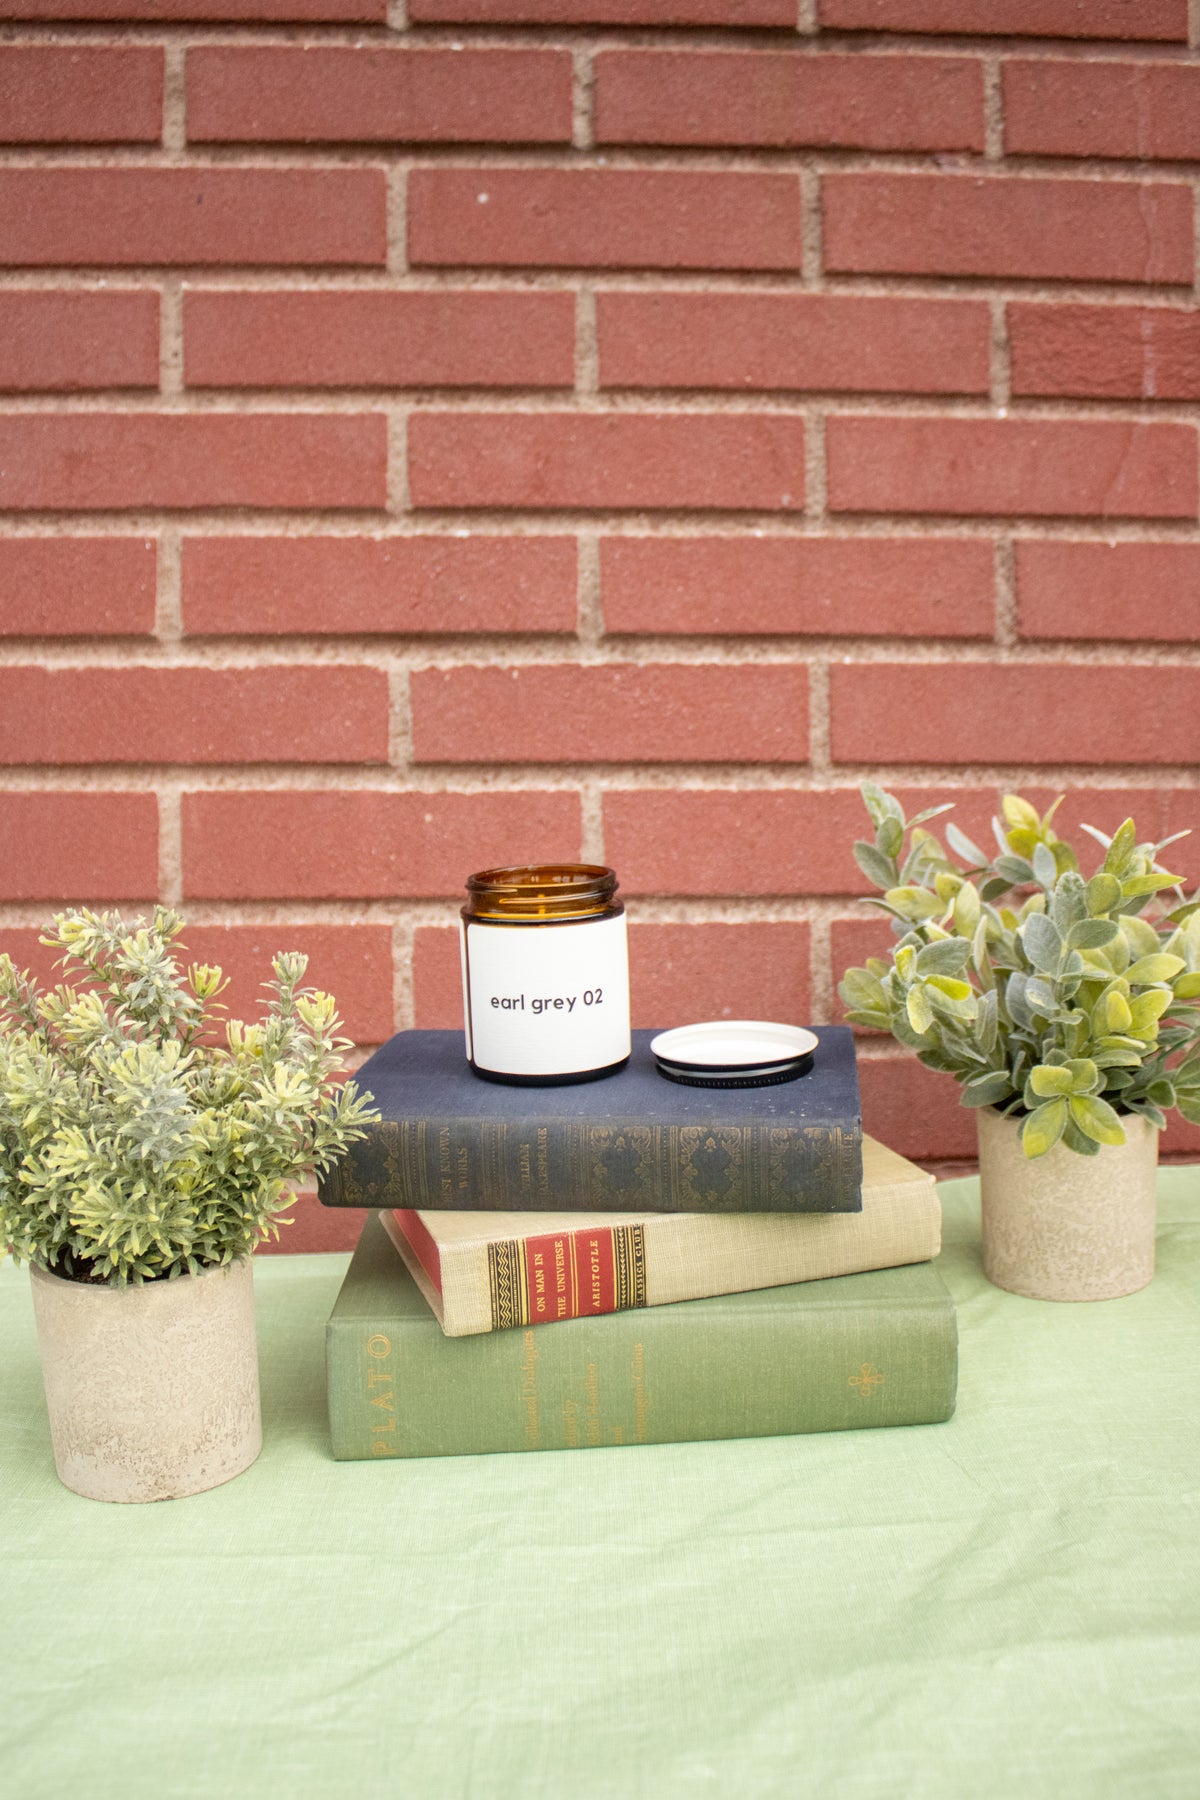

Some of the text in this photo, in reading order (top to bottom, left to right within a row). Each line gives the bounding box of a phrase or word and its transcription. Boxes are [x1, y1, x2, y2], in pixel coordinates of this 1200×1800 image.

[490, 988, 603, 1014] earl grey 02
[439, 1126, 451, 1172] KNOWN
[457, 1147, 469, 1189] WORKS
[633, 1228, 642, 1257] CLUB
[534, 1253, 546, 1312] ON MAN IN
[555, 1240, 566, 1317] THE UNIVERSE
[590, 1240, 601, 1308] ARISTOTLE
[367, 1334, 398, 1455] PLATO
